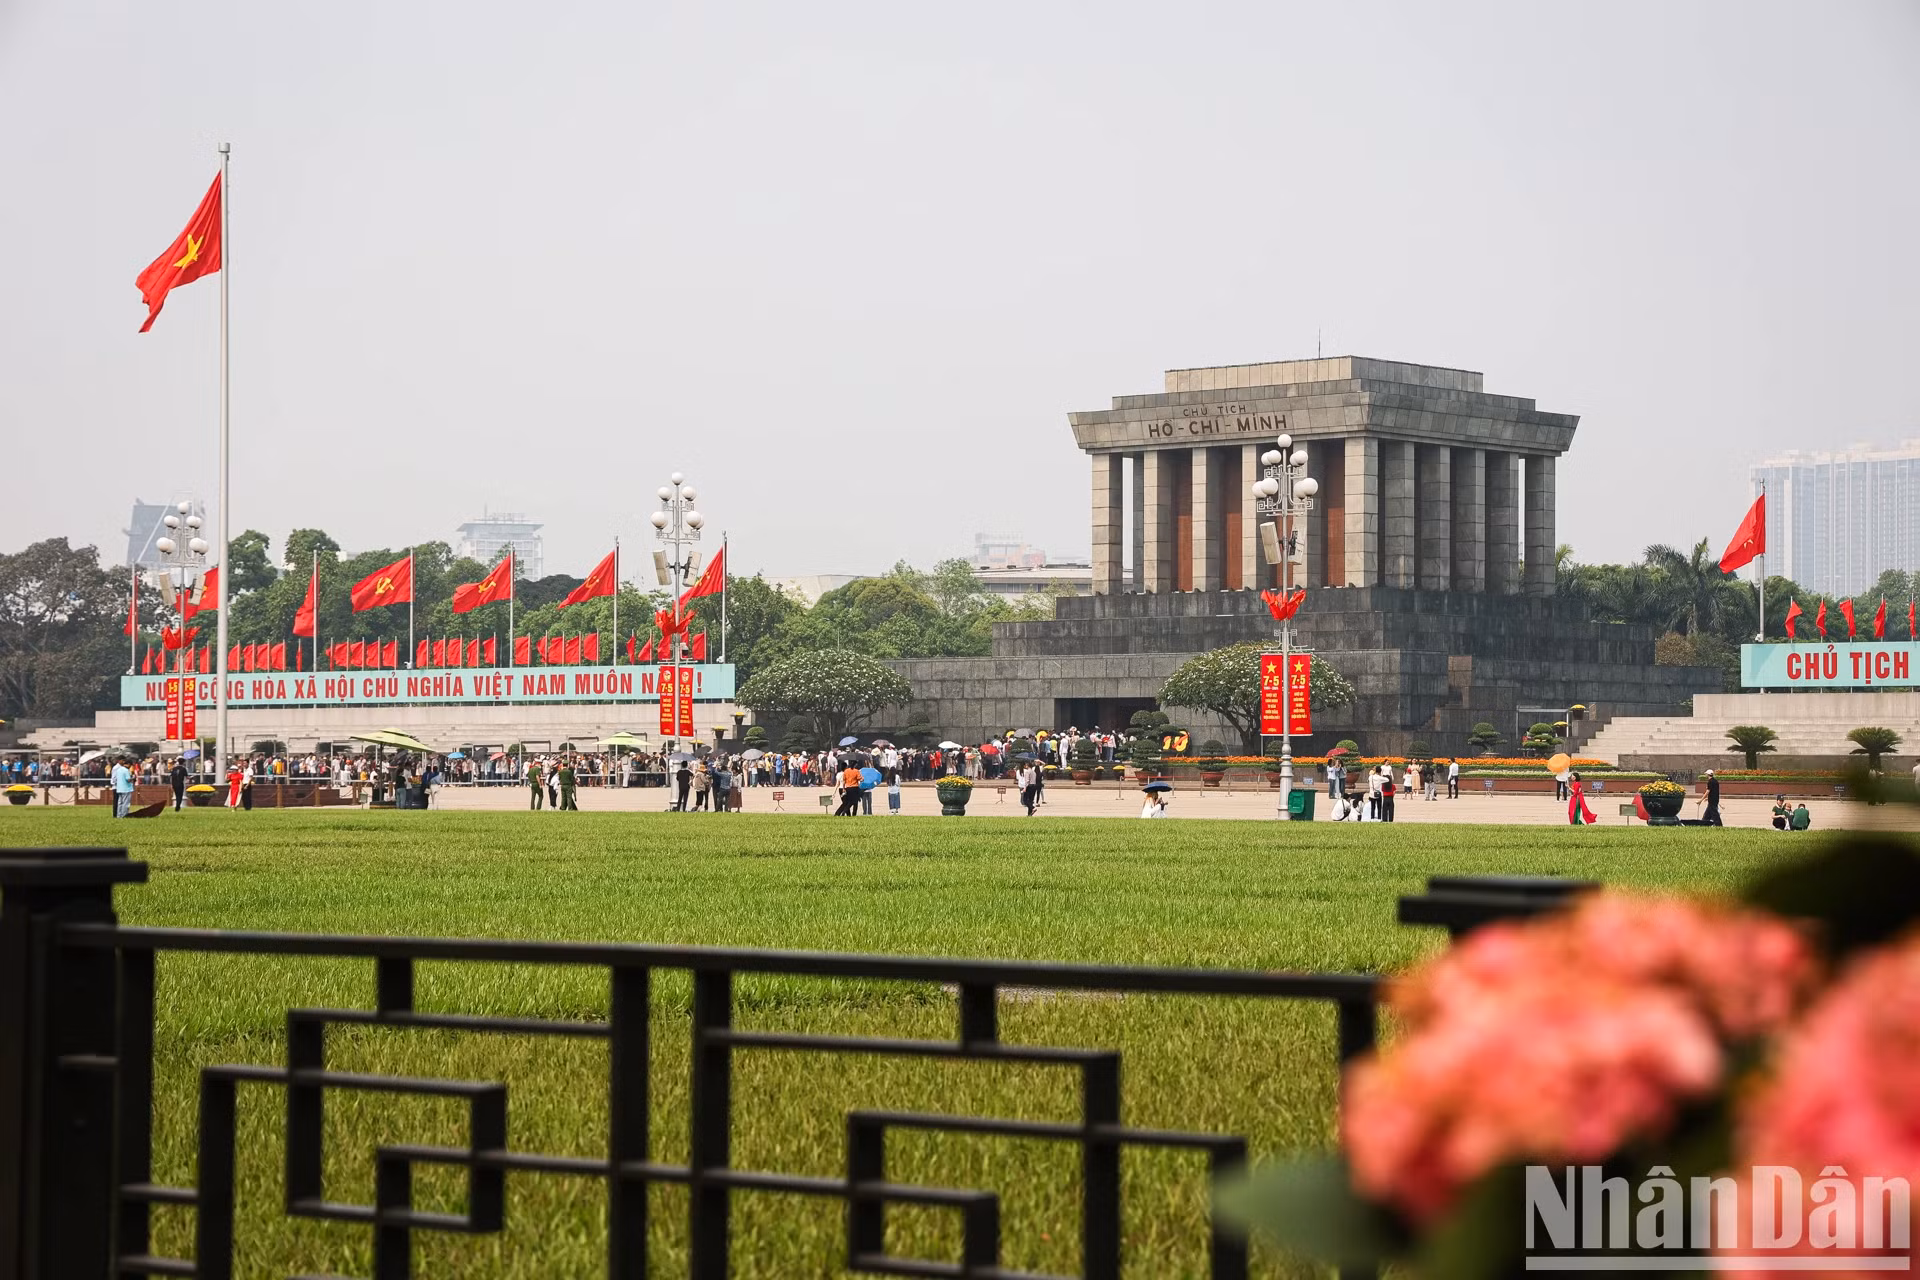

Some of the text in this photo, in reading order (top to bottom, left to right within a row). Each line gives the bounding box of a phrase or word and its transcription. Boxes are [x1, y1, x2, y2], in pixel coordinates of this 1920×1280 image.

[1786, 644, 1909, 685] CHỦ TỊCH
[252, 675, 287, 700] HÒA
[294, 675, 318, 699] XÃ
[325, 674, 355, 702] HỘI
[363, 671, 399, 698] CHỦ
[407, 672, 464, 697] NGHĨA
[473, 671, 514, 700] VIỆT
[523, 674, 566, 696] NAM
[575, 668, 632, 695] MUÔN
